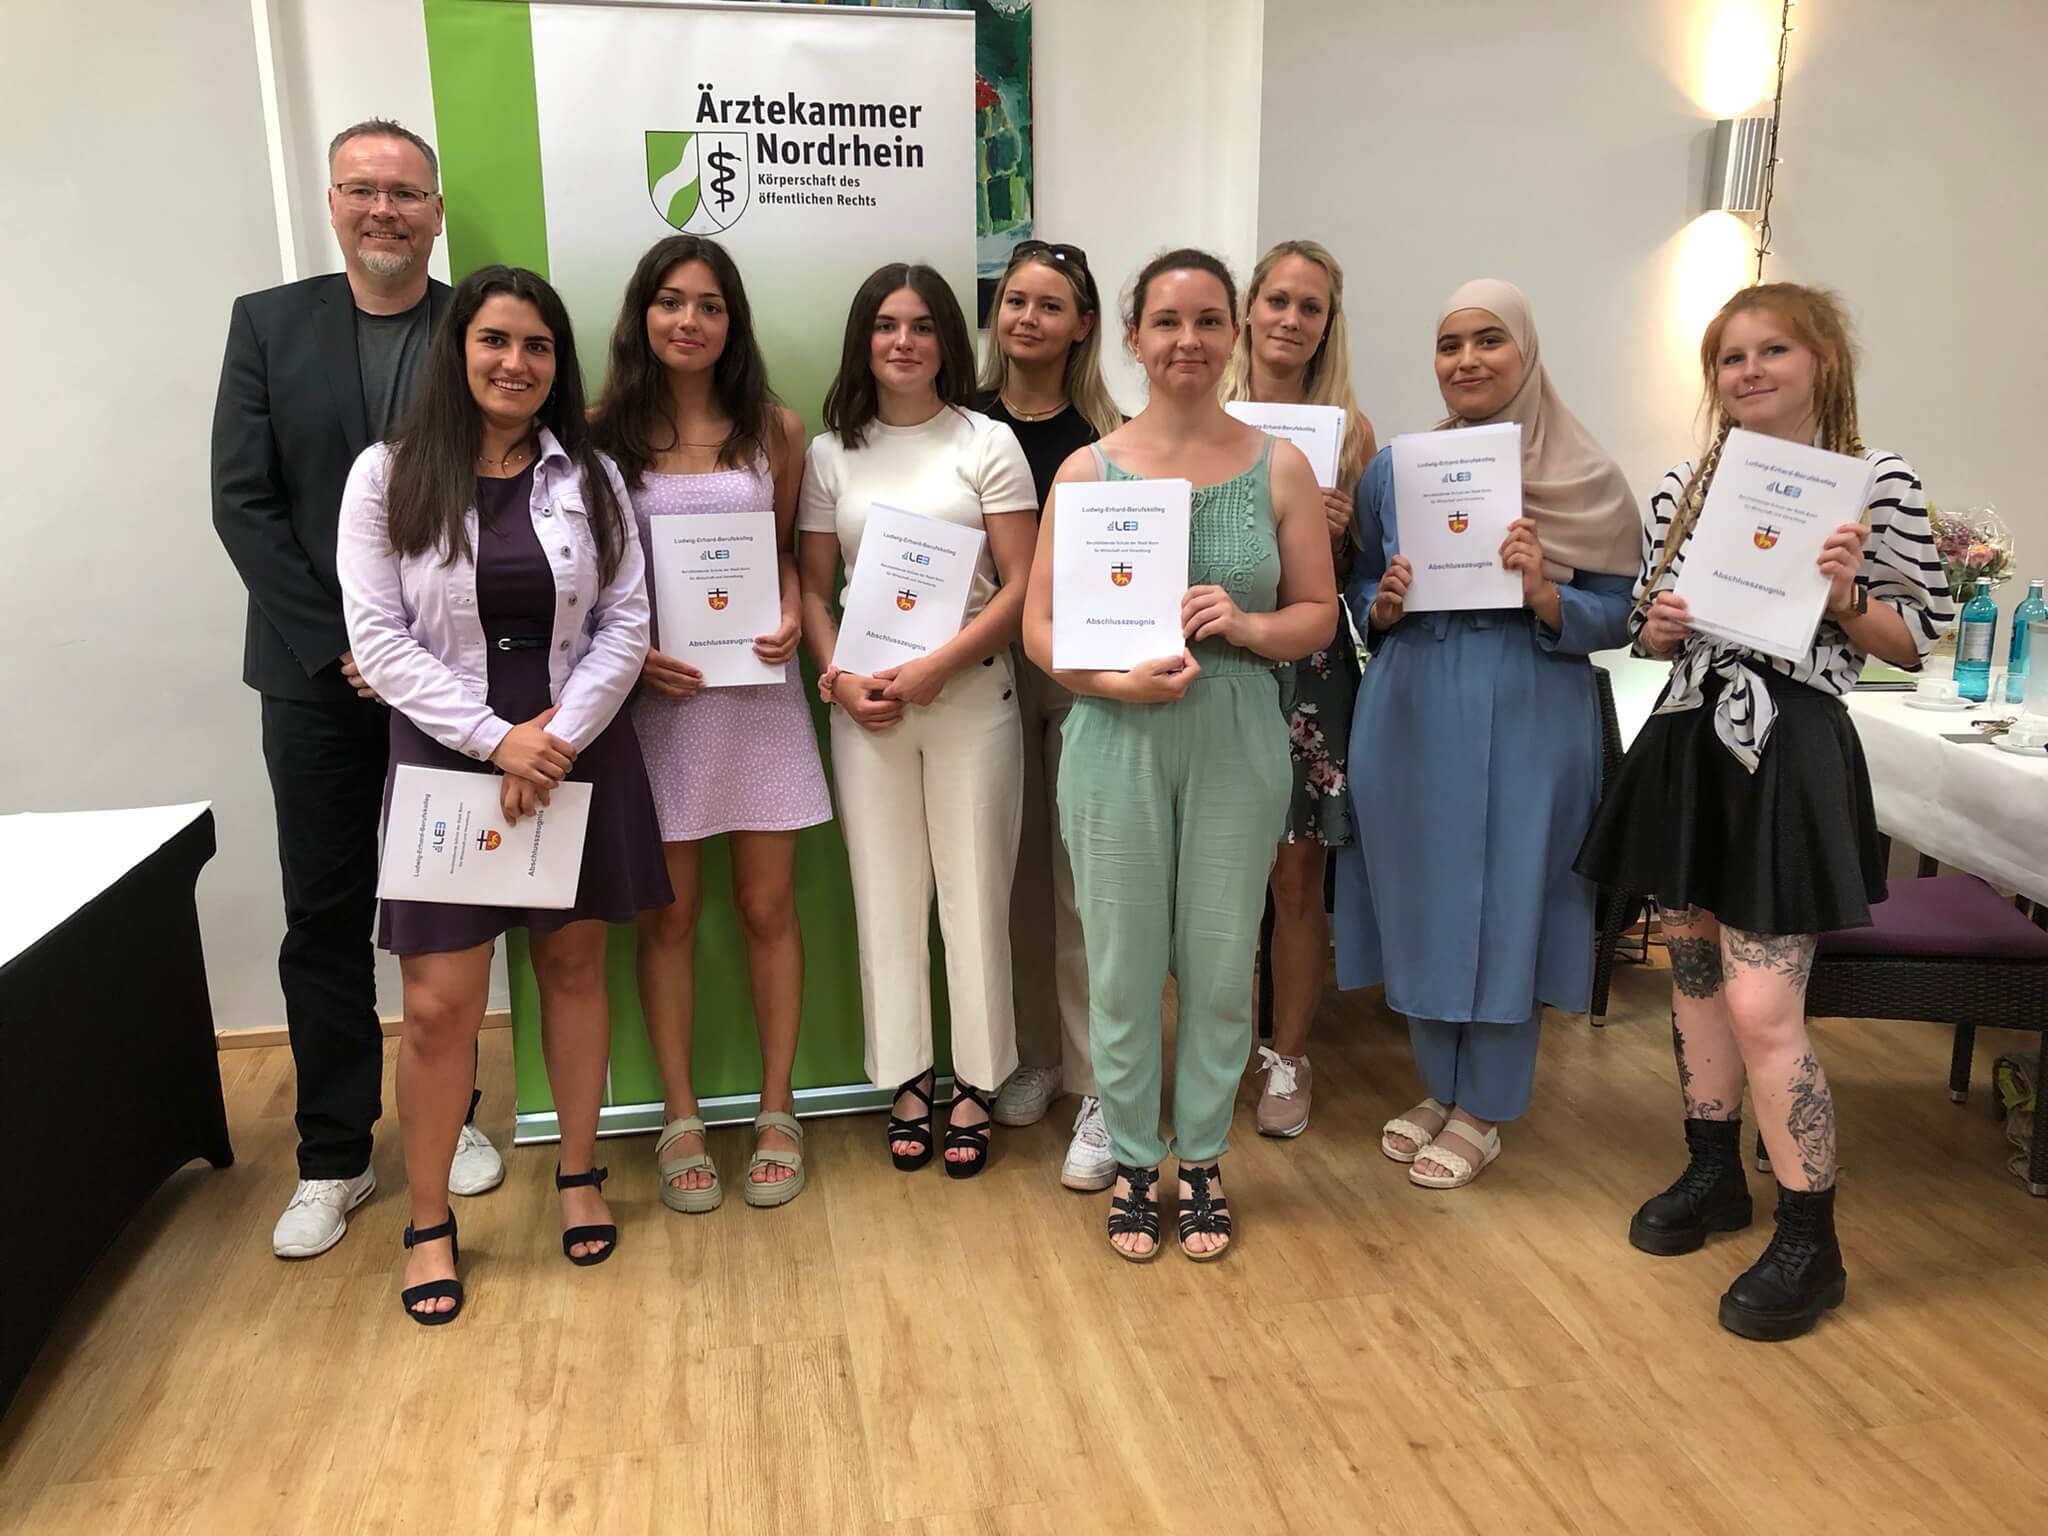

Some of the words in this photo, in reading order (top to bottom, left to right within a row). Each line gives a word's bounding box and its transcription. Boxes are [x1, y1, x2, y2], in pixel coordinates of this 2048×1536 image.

[695, 83, 922, 128] Ärztekammer
[756, 133, 924, 168] Nordrhein
[758, 173, 836, 188] Körperschaft
[840, 175, 861, 188] des
[759, 192, 833, 206] öffentlichen
[837, 194, 877, 207] Rechts
[1427, 560, 1493, 570] Abschlusszeugnis
[1712, 569, 1786, 597] Abschlusszeugnis
[1085, 617, 1156, 627] Abschlusszeugnis
[688, 637, 754, 648] Abschlusszeugnis
[865, 630, 927, 652] Abschlusszeugnis
[527, 809, 545, 878] Abschlusszeugnis
